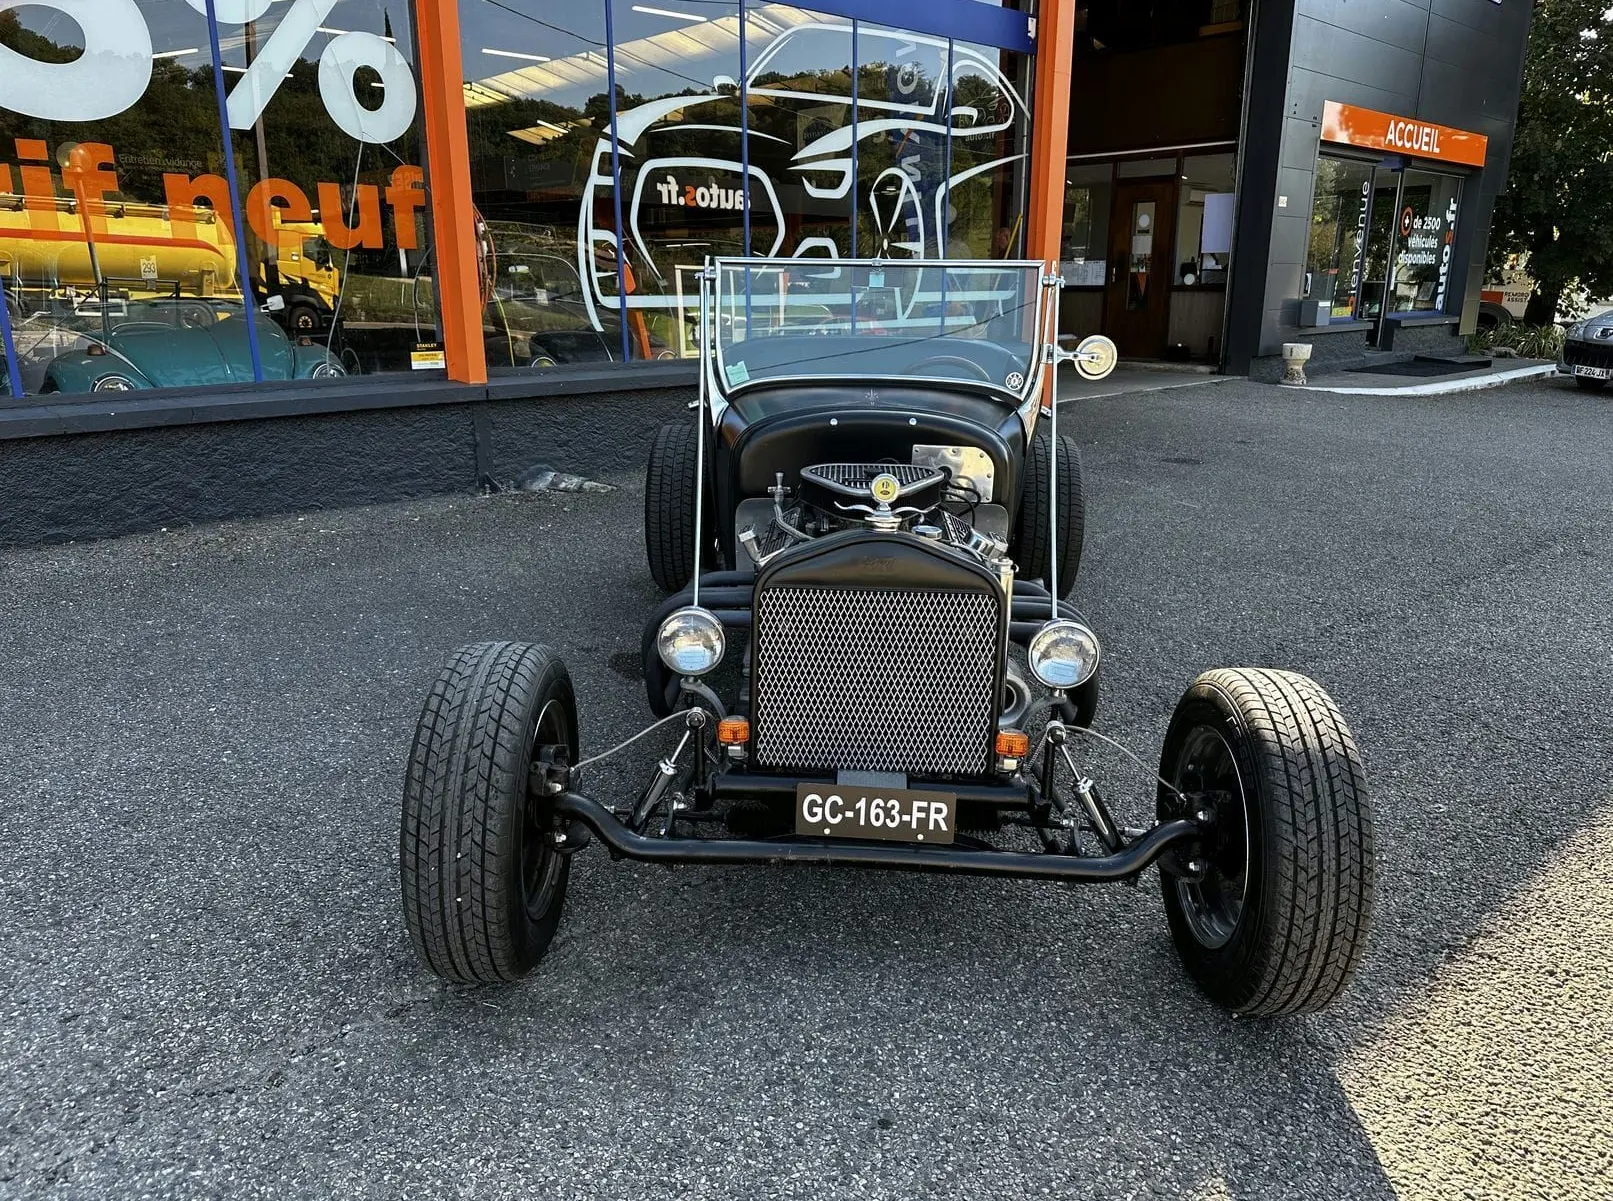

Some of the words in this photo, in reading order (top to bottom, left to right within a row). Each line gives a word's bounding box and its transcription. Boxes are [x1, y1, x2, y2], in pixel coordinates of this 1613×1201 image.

[1385, 119, 1440, 154] ACCUEIL
[163, 165, 426, 249] neuf
[1413, 215, 1423, 229] de
[1423, 217, 1441, 231] 2500
[1407, 234, 1438, 249] véhicules
[1398, 250, 1436, 267] disponibles
[142, 262, 156, 274] 293
[802, 793, 949, 832] GC-163-FR
